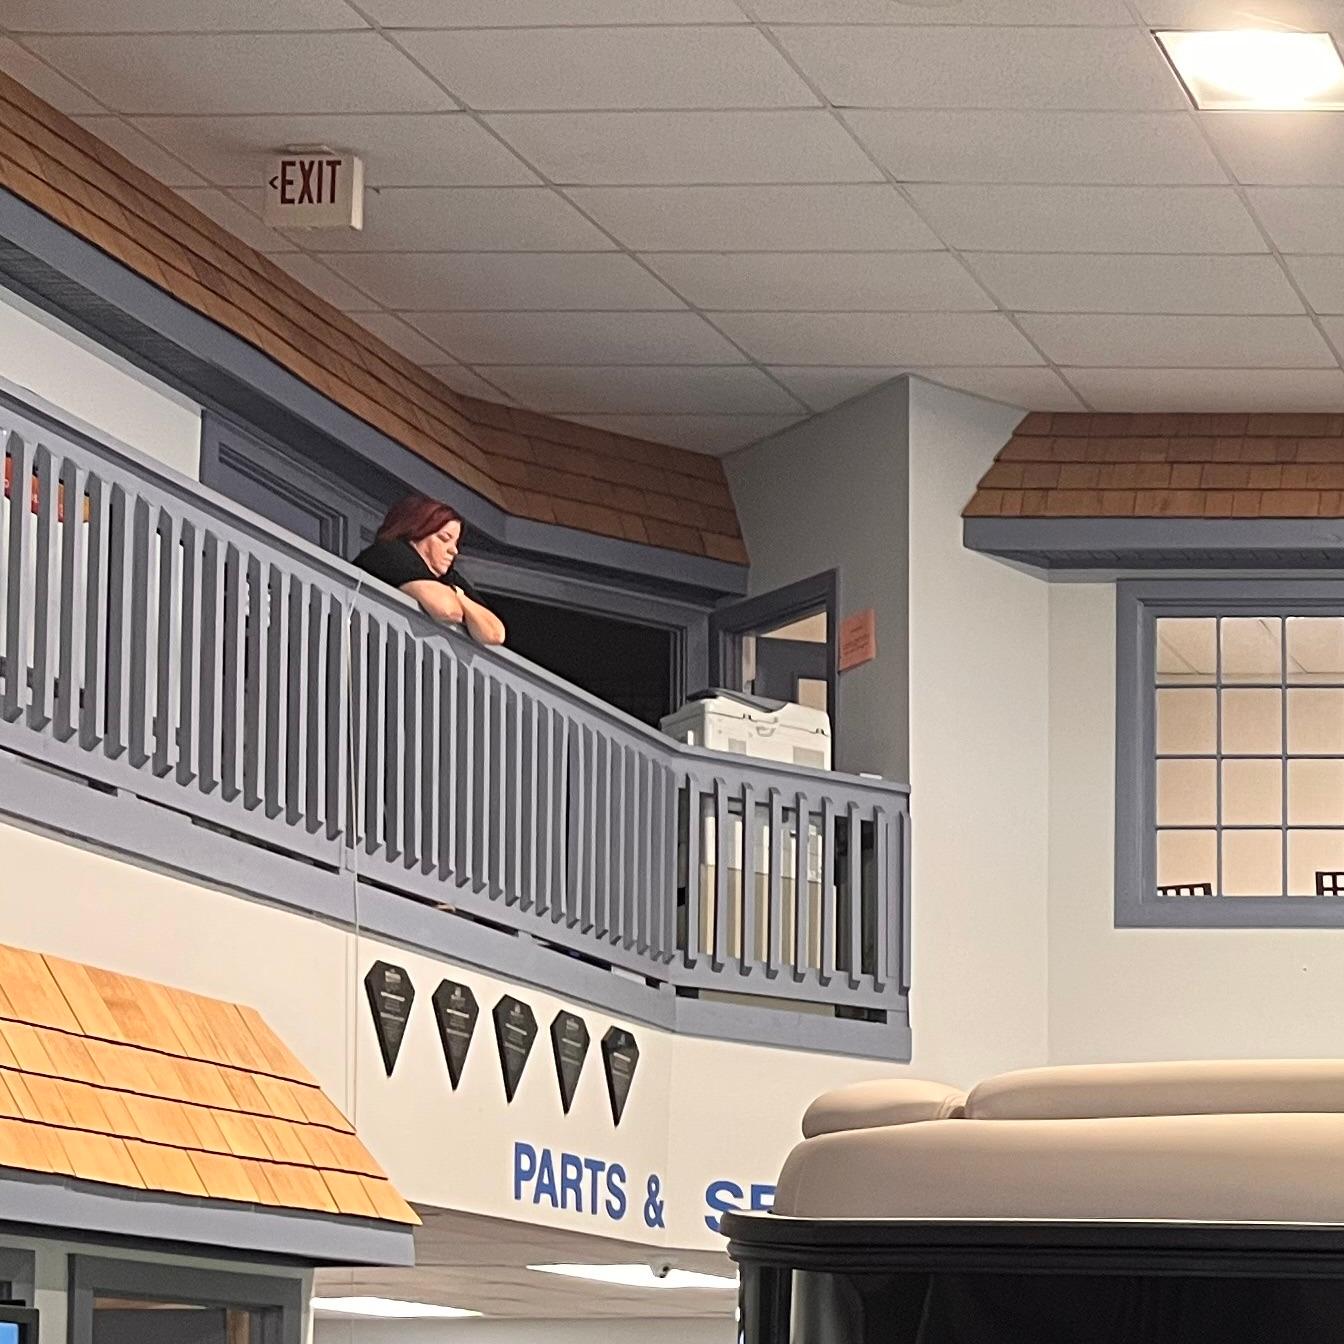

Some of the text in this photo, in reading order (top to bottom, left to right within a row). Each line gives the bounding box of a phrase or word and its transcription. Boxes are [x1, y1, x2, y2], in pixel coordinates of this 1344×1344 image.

[280, 160, 342, 205] EXIT
[513, 1141, 627, 1221] PARTS
[643, 1174, 666, 1229] &
